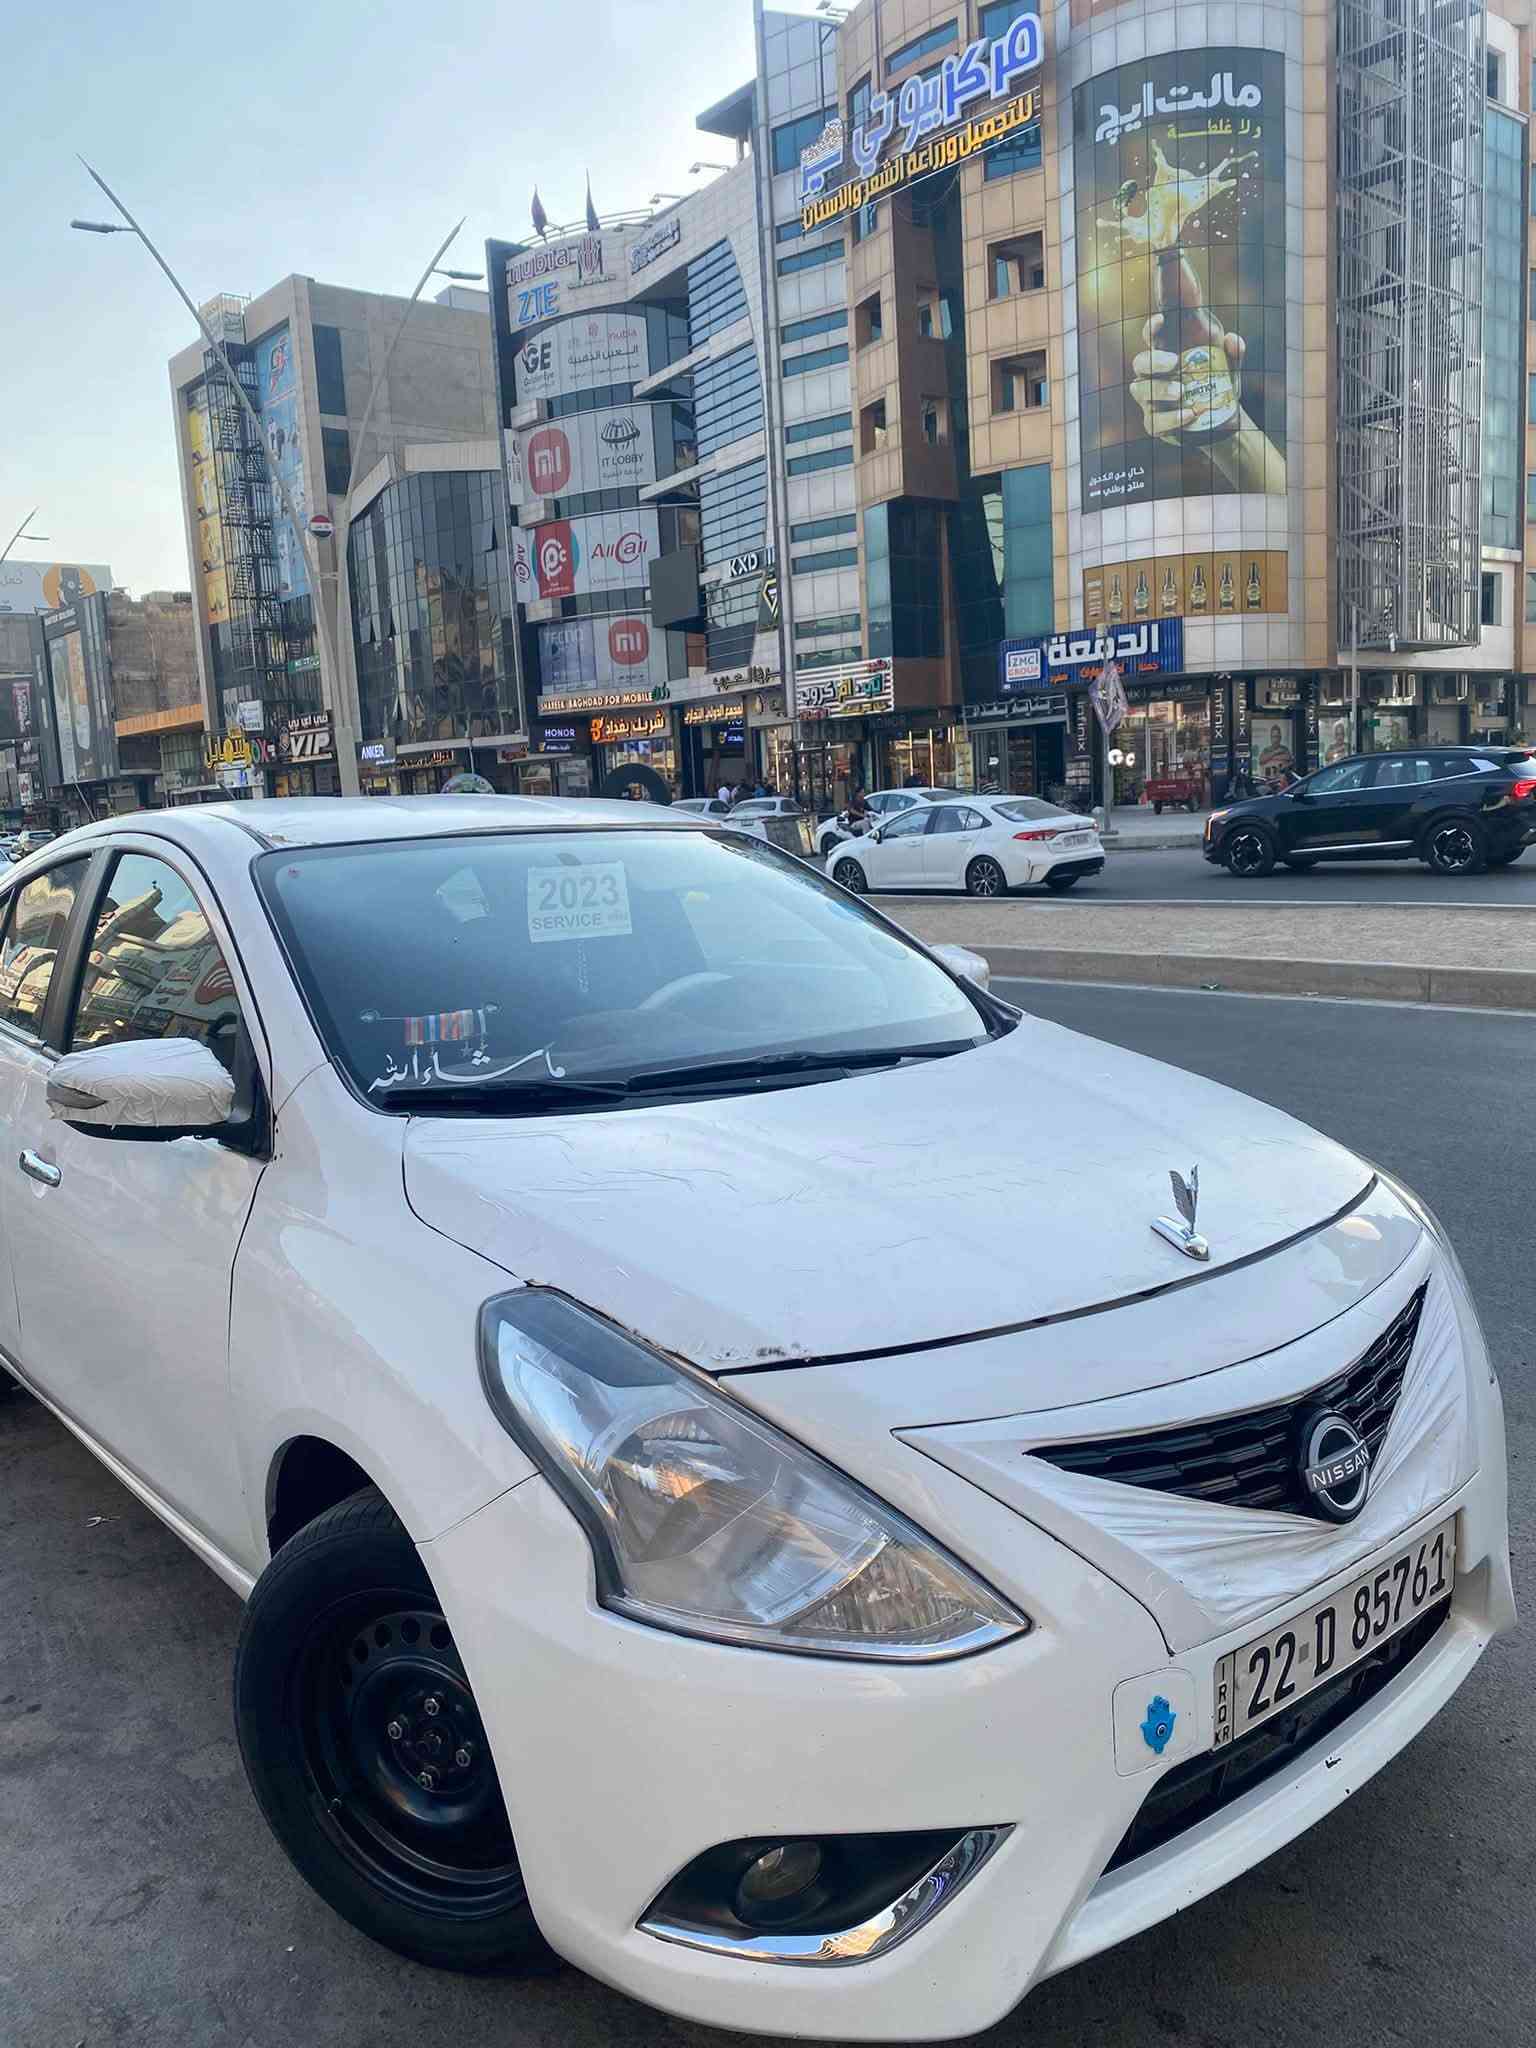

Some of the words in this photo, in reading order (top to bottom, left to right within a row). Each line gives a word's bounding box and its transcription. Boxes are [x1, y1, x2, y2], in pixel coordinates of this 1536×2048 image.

[942, 13, 1044, 126] مركز
[1156, 72, 1262, 113] مالت
[958, 93, 1034, 155] للتجميل
[907, 134, 959, 178] وزراعة
[506, 247, 570, 286] nubia
[517, 280, 560, 326] ZTE
[612, 453, 644, 466] LOBBY
[592, 531, 648, 565] AllCall
[728, 553, 759, 577] KXD
[622, 691, 653, 704] MOBILE
[1215, 688, 1225, 739] infinix
[289, 733, 330, 757] VIP
[544, 728, 576, 737] HONOR
[361, 744, 385, 760] ANKER
[538, 874, 620, 911] 2023
[532, 912, 602, 930] SERVICE
[1311, 1447, 1370, 1489] NISSAN
[1247, 1631, 1297, 1720] 22
[1313, 1606, 1336, 1678] D
[1351, 1532, 1446, 1650] 85761
[1214, 1725, 1230, 1746] KR
